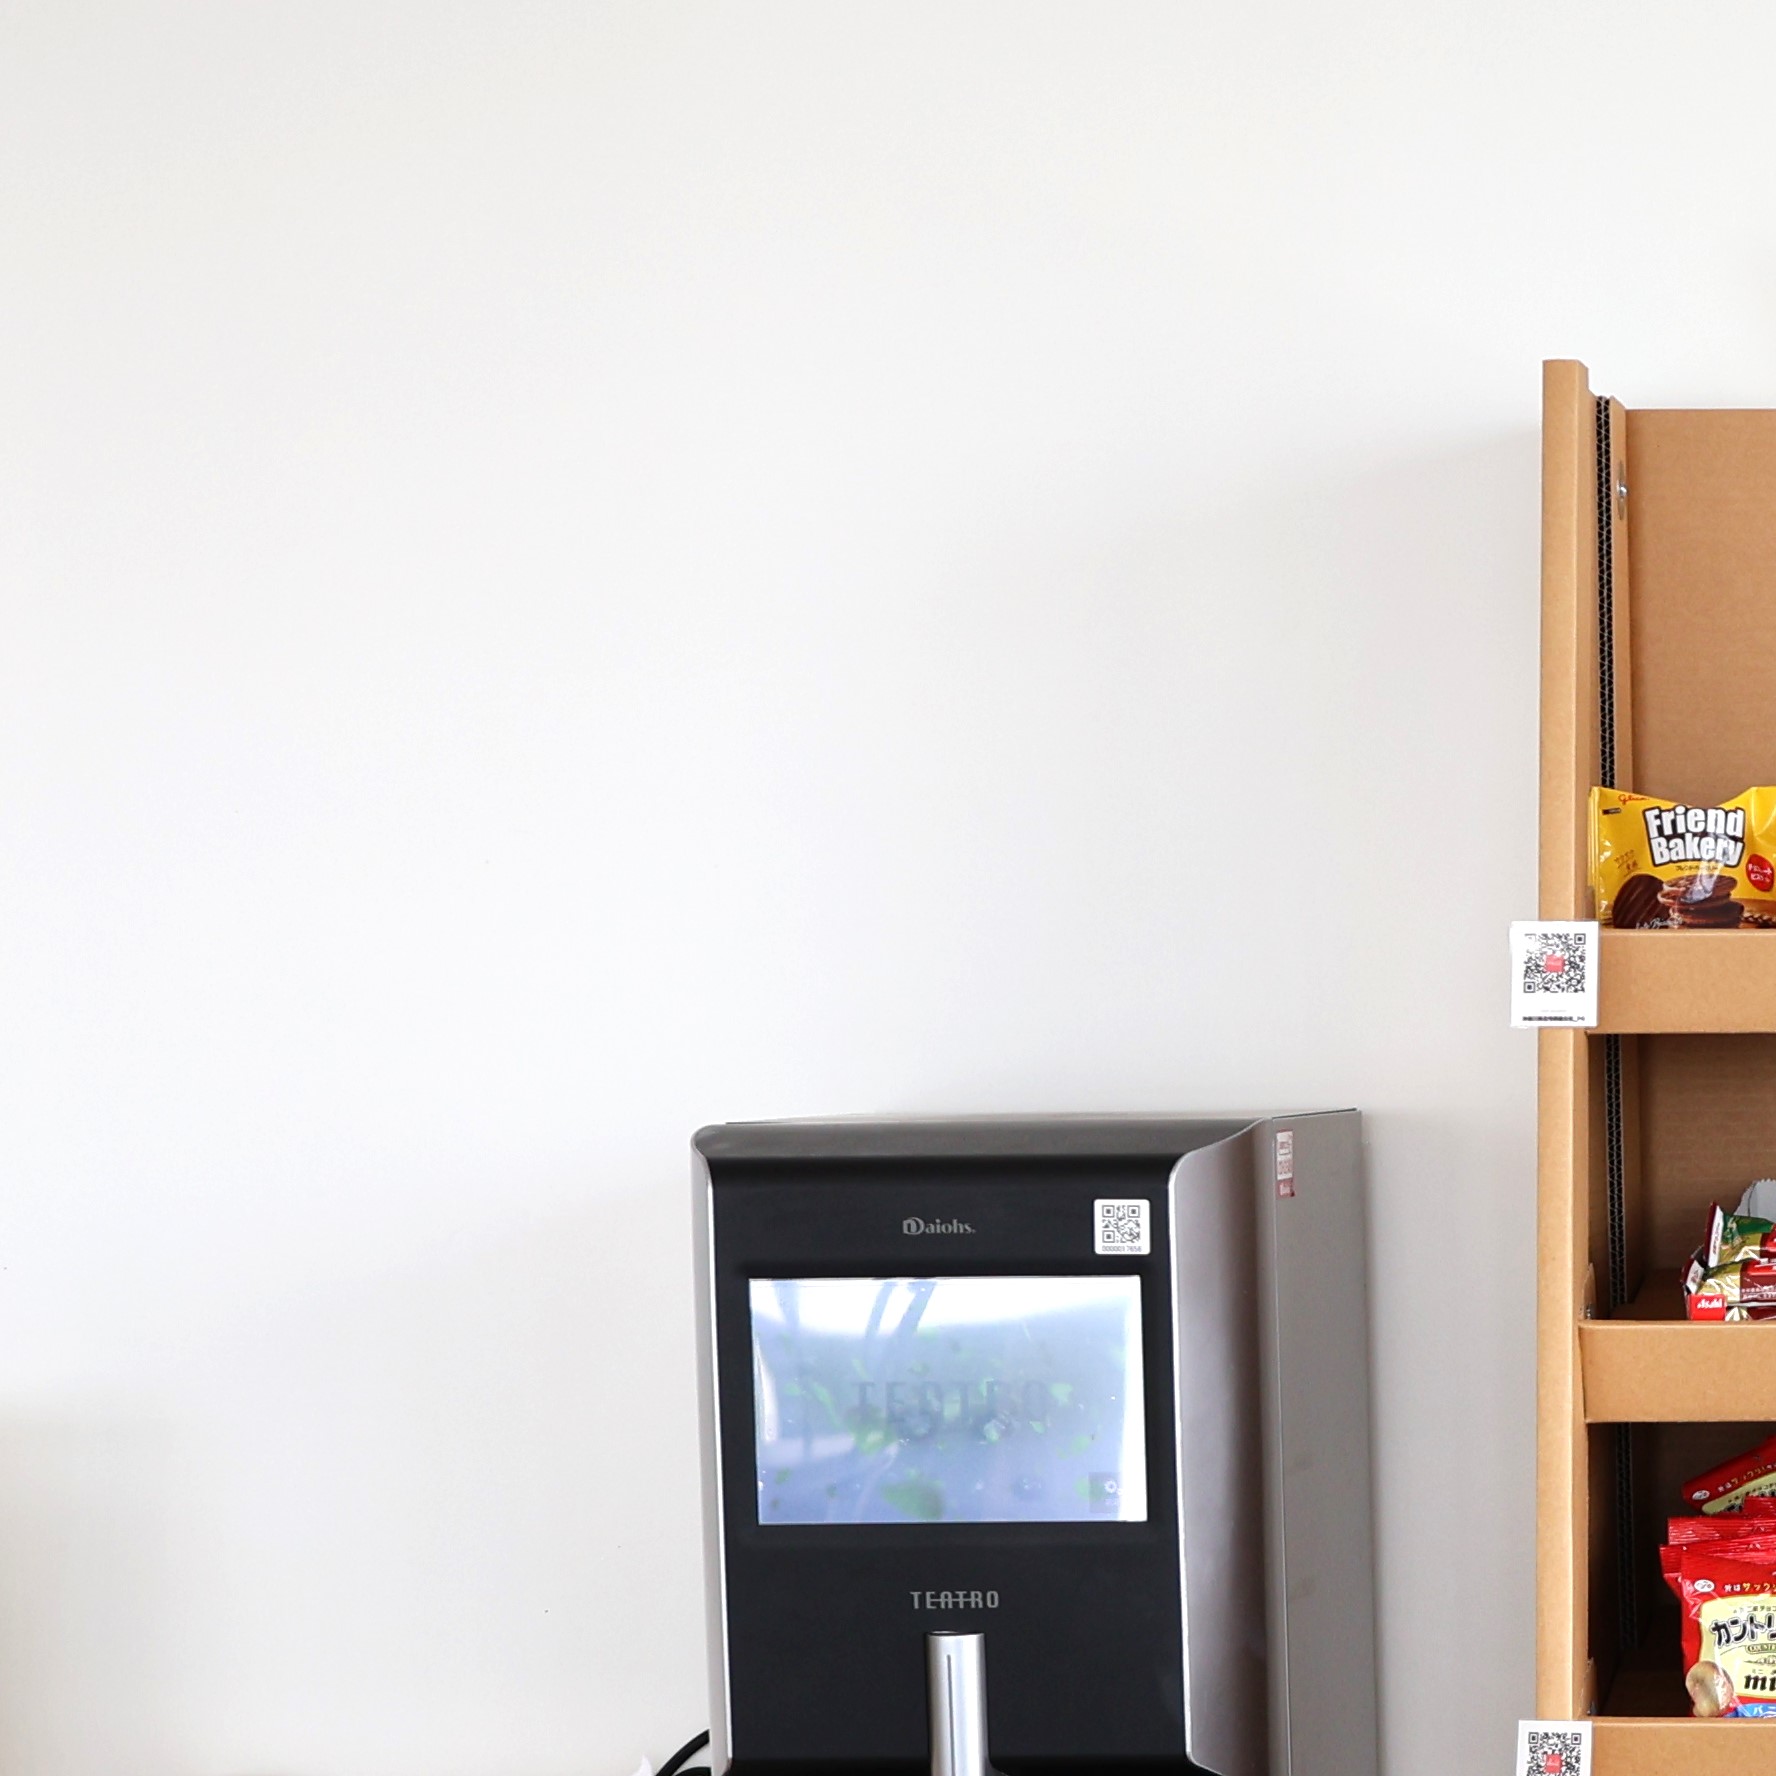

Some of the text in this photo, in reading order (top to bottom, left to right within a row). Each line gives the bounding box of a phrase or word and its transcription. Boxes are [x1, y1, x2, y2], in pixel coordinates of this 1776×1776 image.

[1644, 806, 1745, 839] Friend
[1649, 832, 1745, 867] Bakery
[1697, 1299, 1723, 1308] Asahi
[910, 1591, 999, 1609] TEATRO
